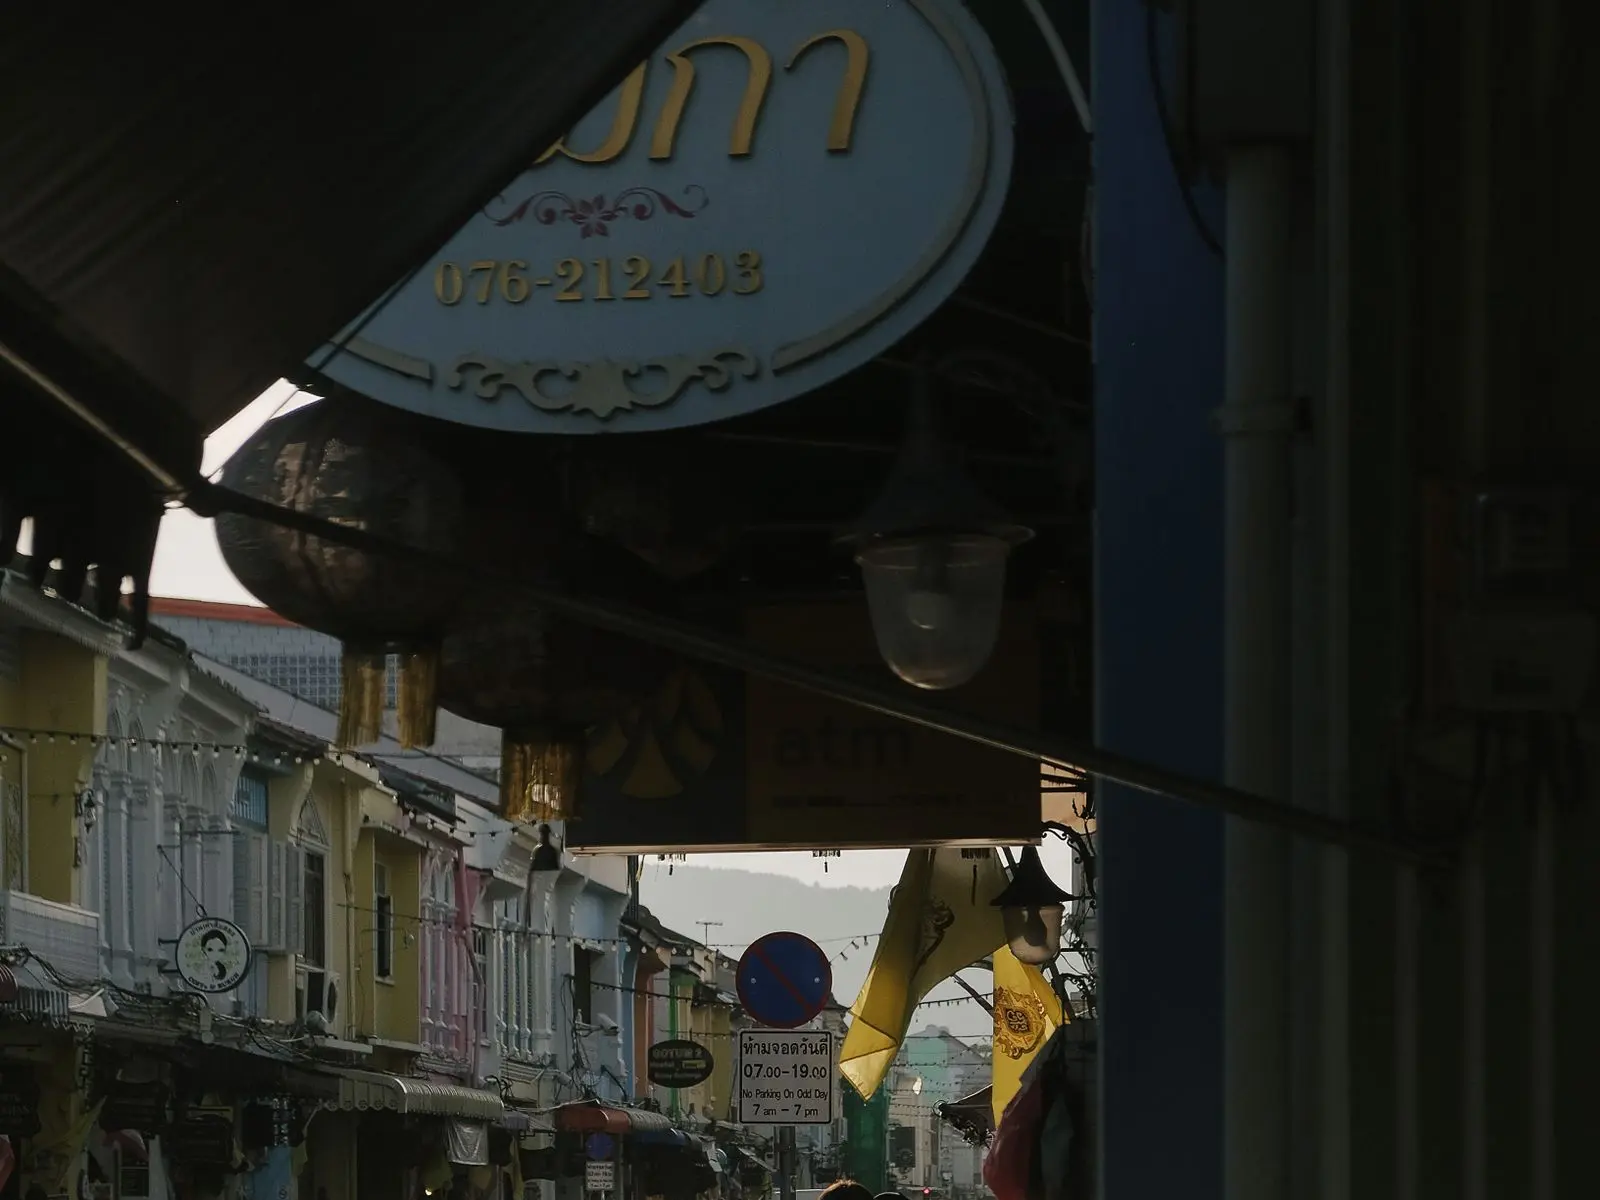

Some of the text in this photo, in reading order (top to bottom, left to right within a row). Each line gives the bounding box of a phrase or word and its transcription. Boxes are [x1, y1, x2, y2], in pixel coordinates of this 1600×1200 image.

[434, 251, 765, 306] 076-212403
[743, 1063, 827, 1079] 07.00-19.00
[742, 1088, 828, 1101] No Parking On Odd Day
[752, 1103, 761, 1116] 7
[763, 1108, 777, 1116] am
[794, 1103, 802, 1116] 7
[804, 1108, 818, 1118] pm
